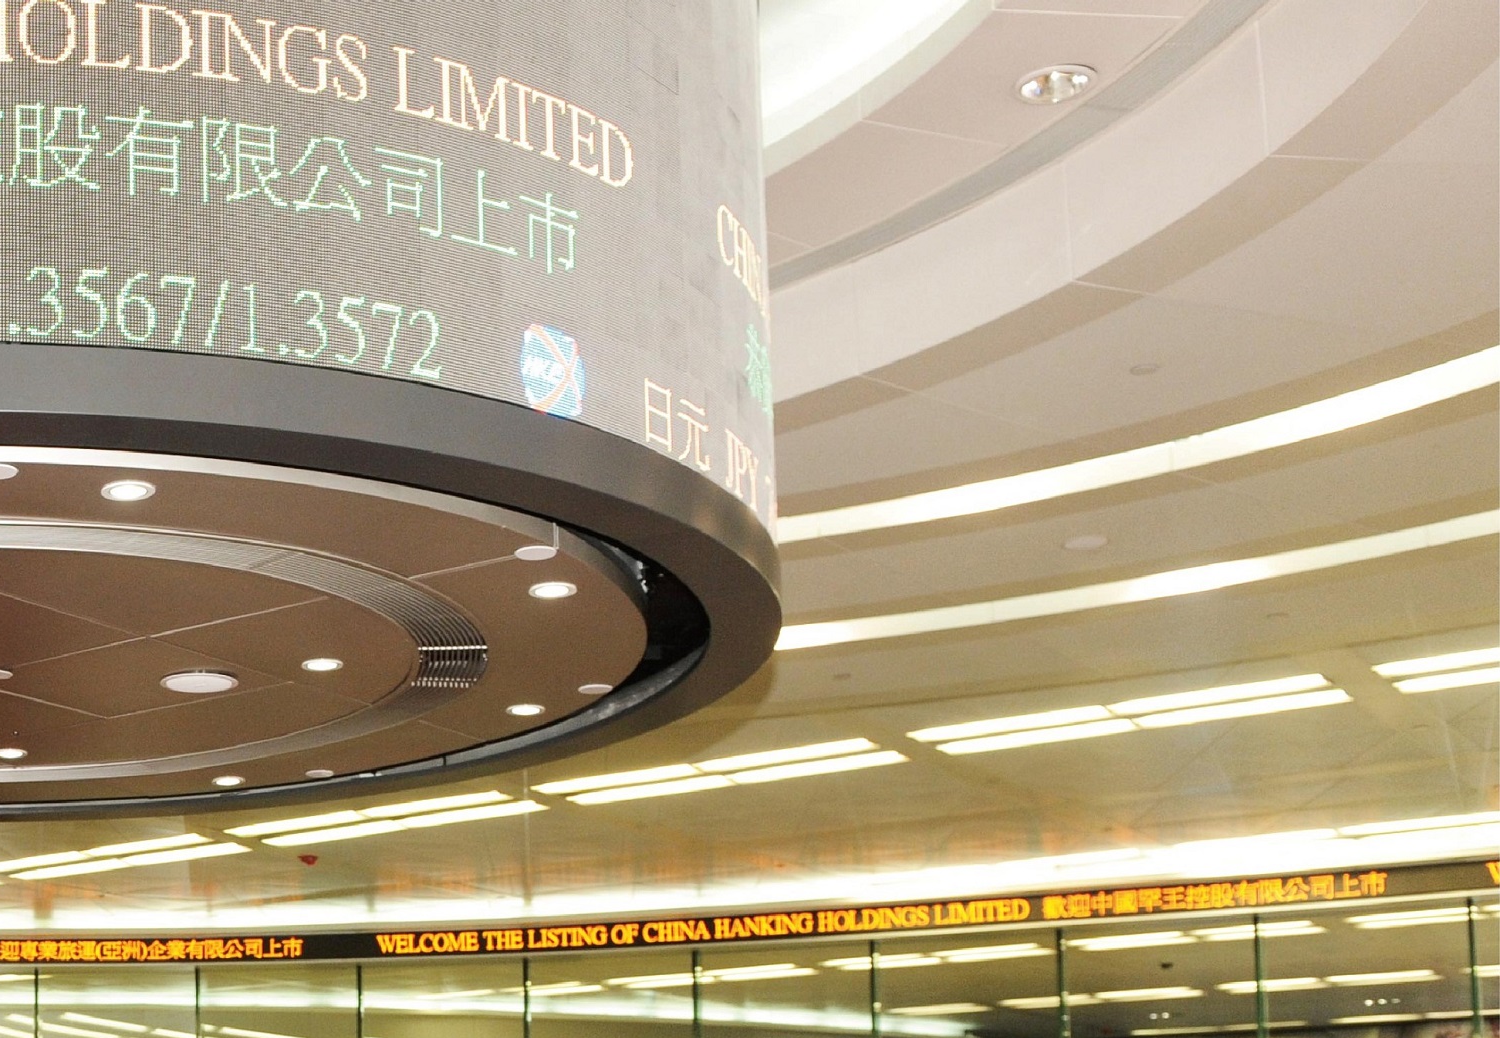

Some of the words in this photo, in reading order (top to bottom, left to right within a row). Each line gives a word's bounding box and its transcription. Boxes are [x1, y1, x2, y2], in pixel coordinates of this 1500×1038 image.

[394, 46, 634, 188] LIMITED
[644, 376, 712, 472] 日元
[724, 428, 759, 512] JPY
[376, 931, 479, 954] WELCOME
[482, 929, 524, 951] THE
[527, 925, 608, 949] LISTING
[610, 923, 639, 945] OF
[642, 920, 710, 943] CHINA
[714, 913, 814, 940] HANKING
[817, 905, 930, 933] HOLDINGS
[935, 898, 1031, 926] LIMITED
